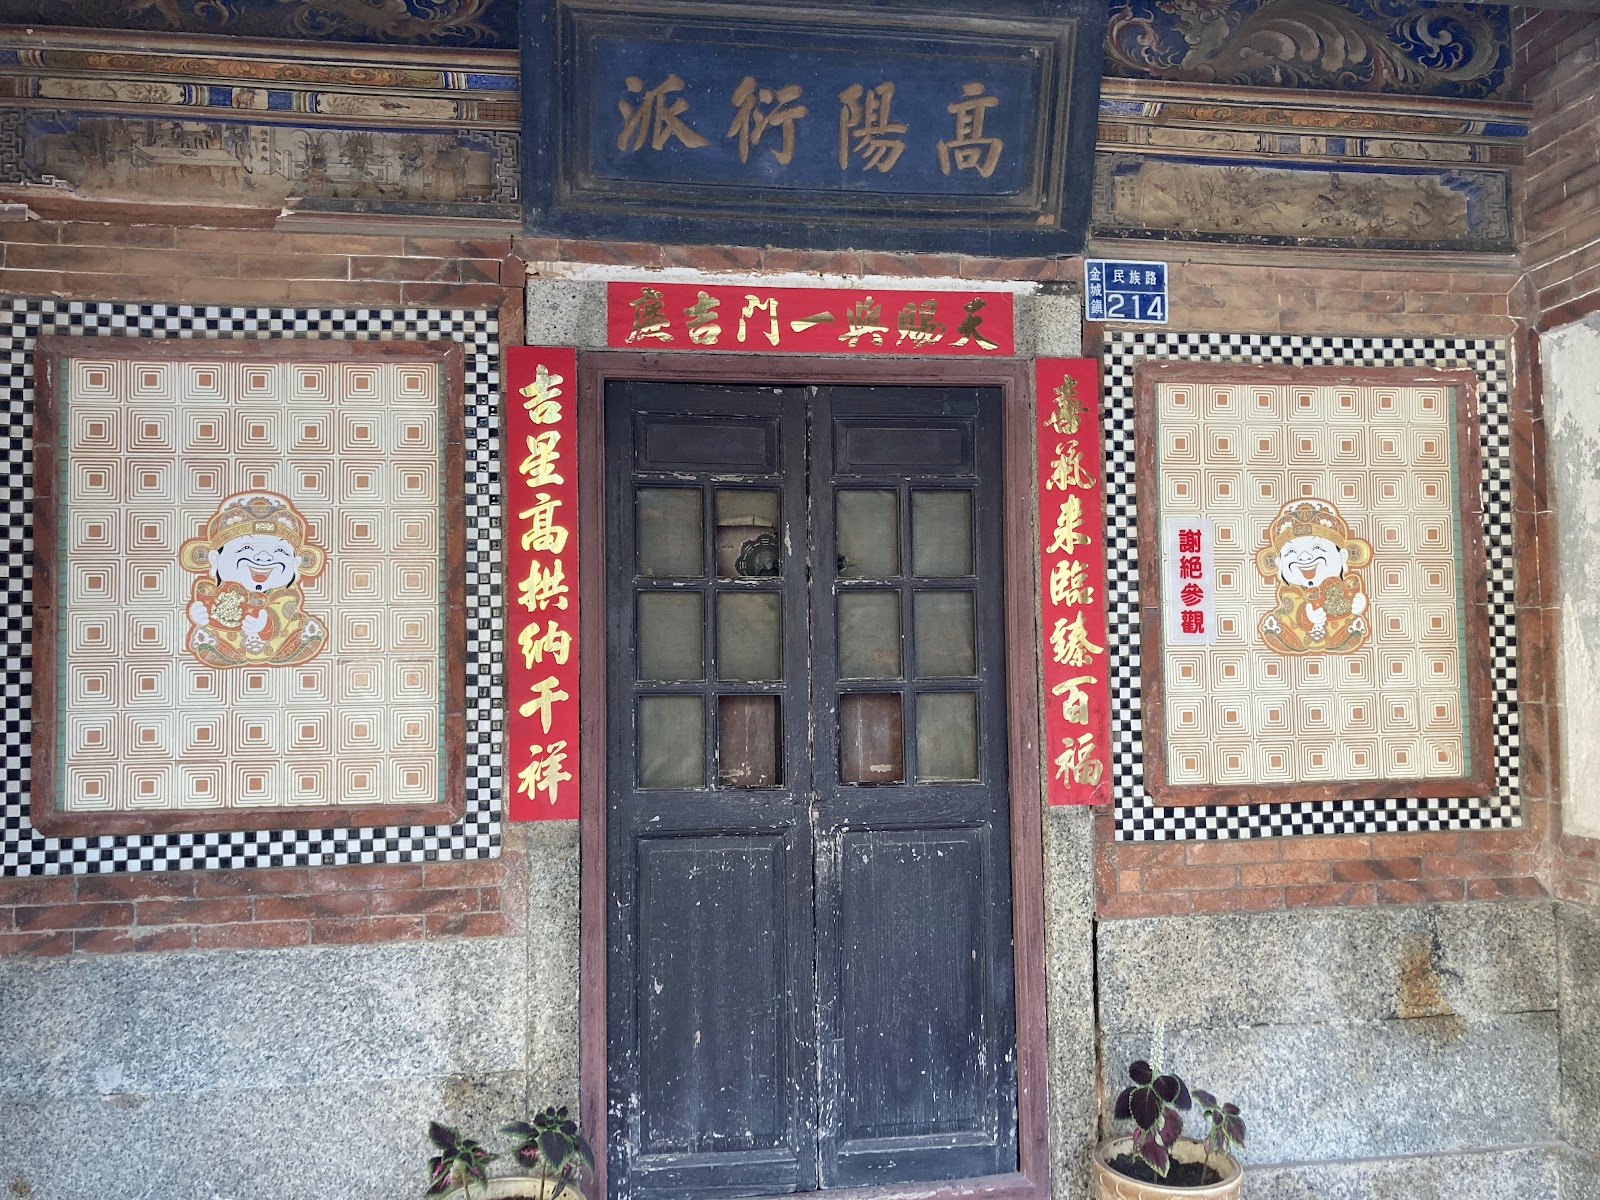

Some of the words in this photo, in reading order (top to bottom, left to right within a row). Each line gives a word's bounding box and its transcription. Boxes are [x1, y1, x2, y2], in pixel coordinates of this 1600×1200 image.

[1089, 266, 1103, 314] 金城鎮
[1112, 269, 1157, 285] 民族路
[1107, 293, 1163, 320] 214
